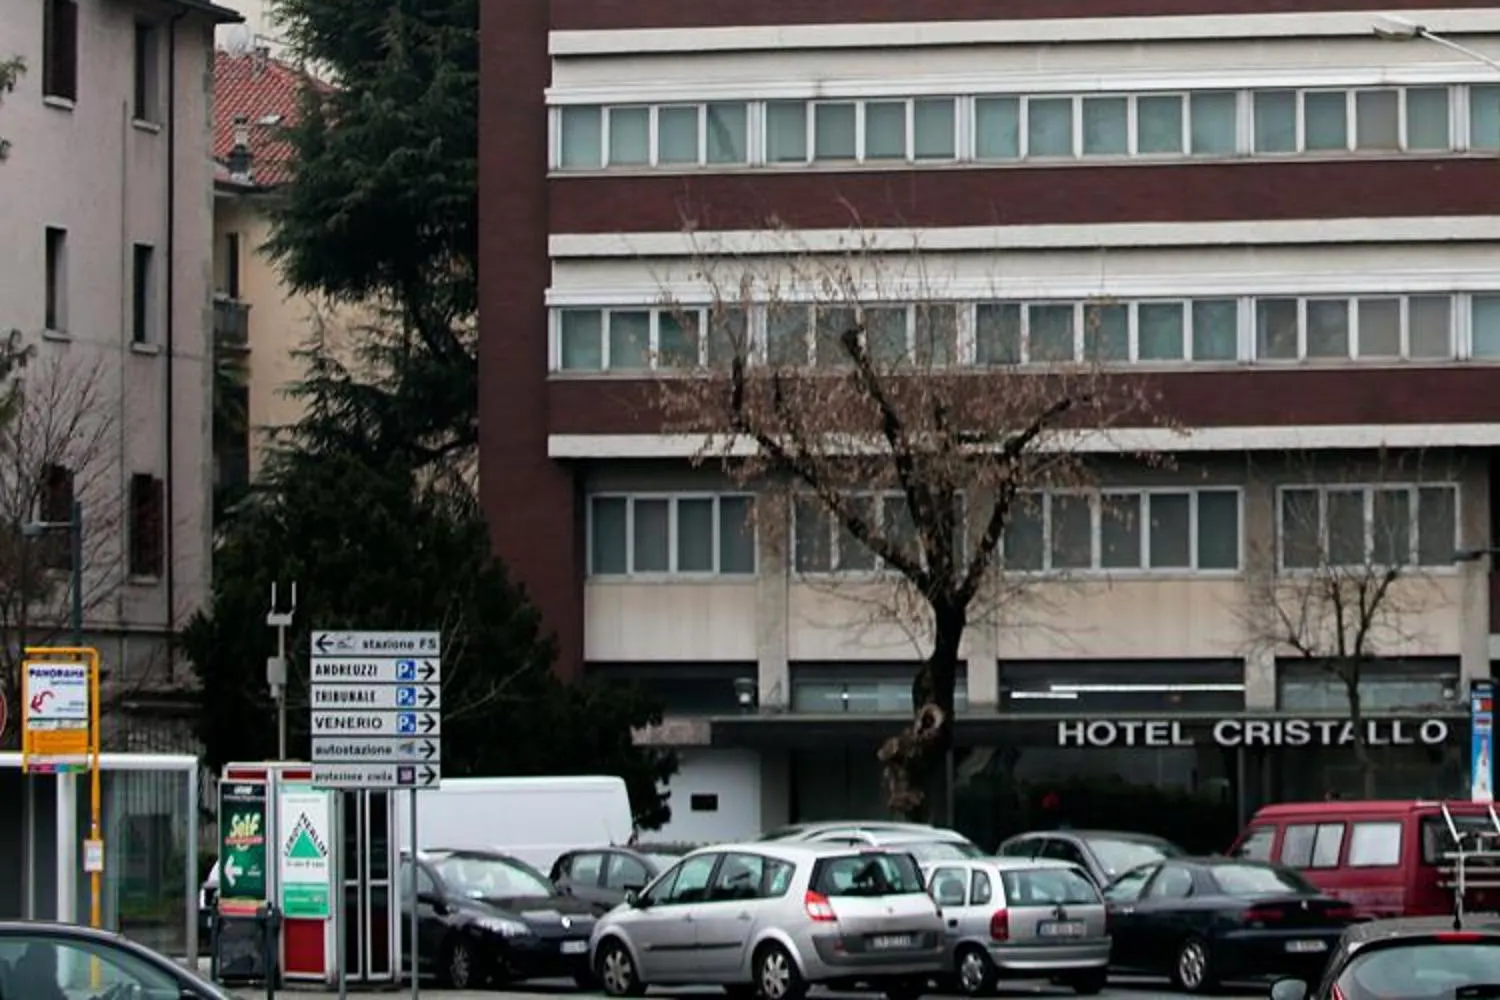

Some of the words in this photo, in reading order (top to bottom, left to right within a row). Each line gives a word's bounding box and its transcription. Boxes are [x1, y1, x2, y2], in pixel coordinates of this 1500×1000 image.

[363, 638, 414, 649] stazione
[419, 637, 437, 649] FS
[30, 669, 84, 677] PANORAMA
[315, 664, 378, 676] ANDREUZZI
[315, 690, 376, 703] TRIBUNALE
[315, 716, 383, 729] VENERIO
[1057, 720, 1194, 746] HOTEL
[1213, 719, 1449, 746] CRISTALLO
[315, 744, 393, 755] autostazione
